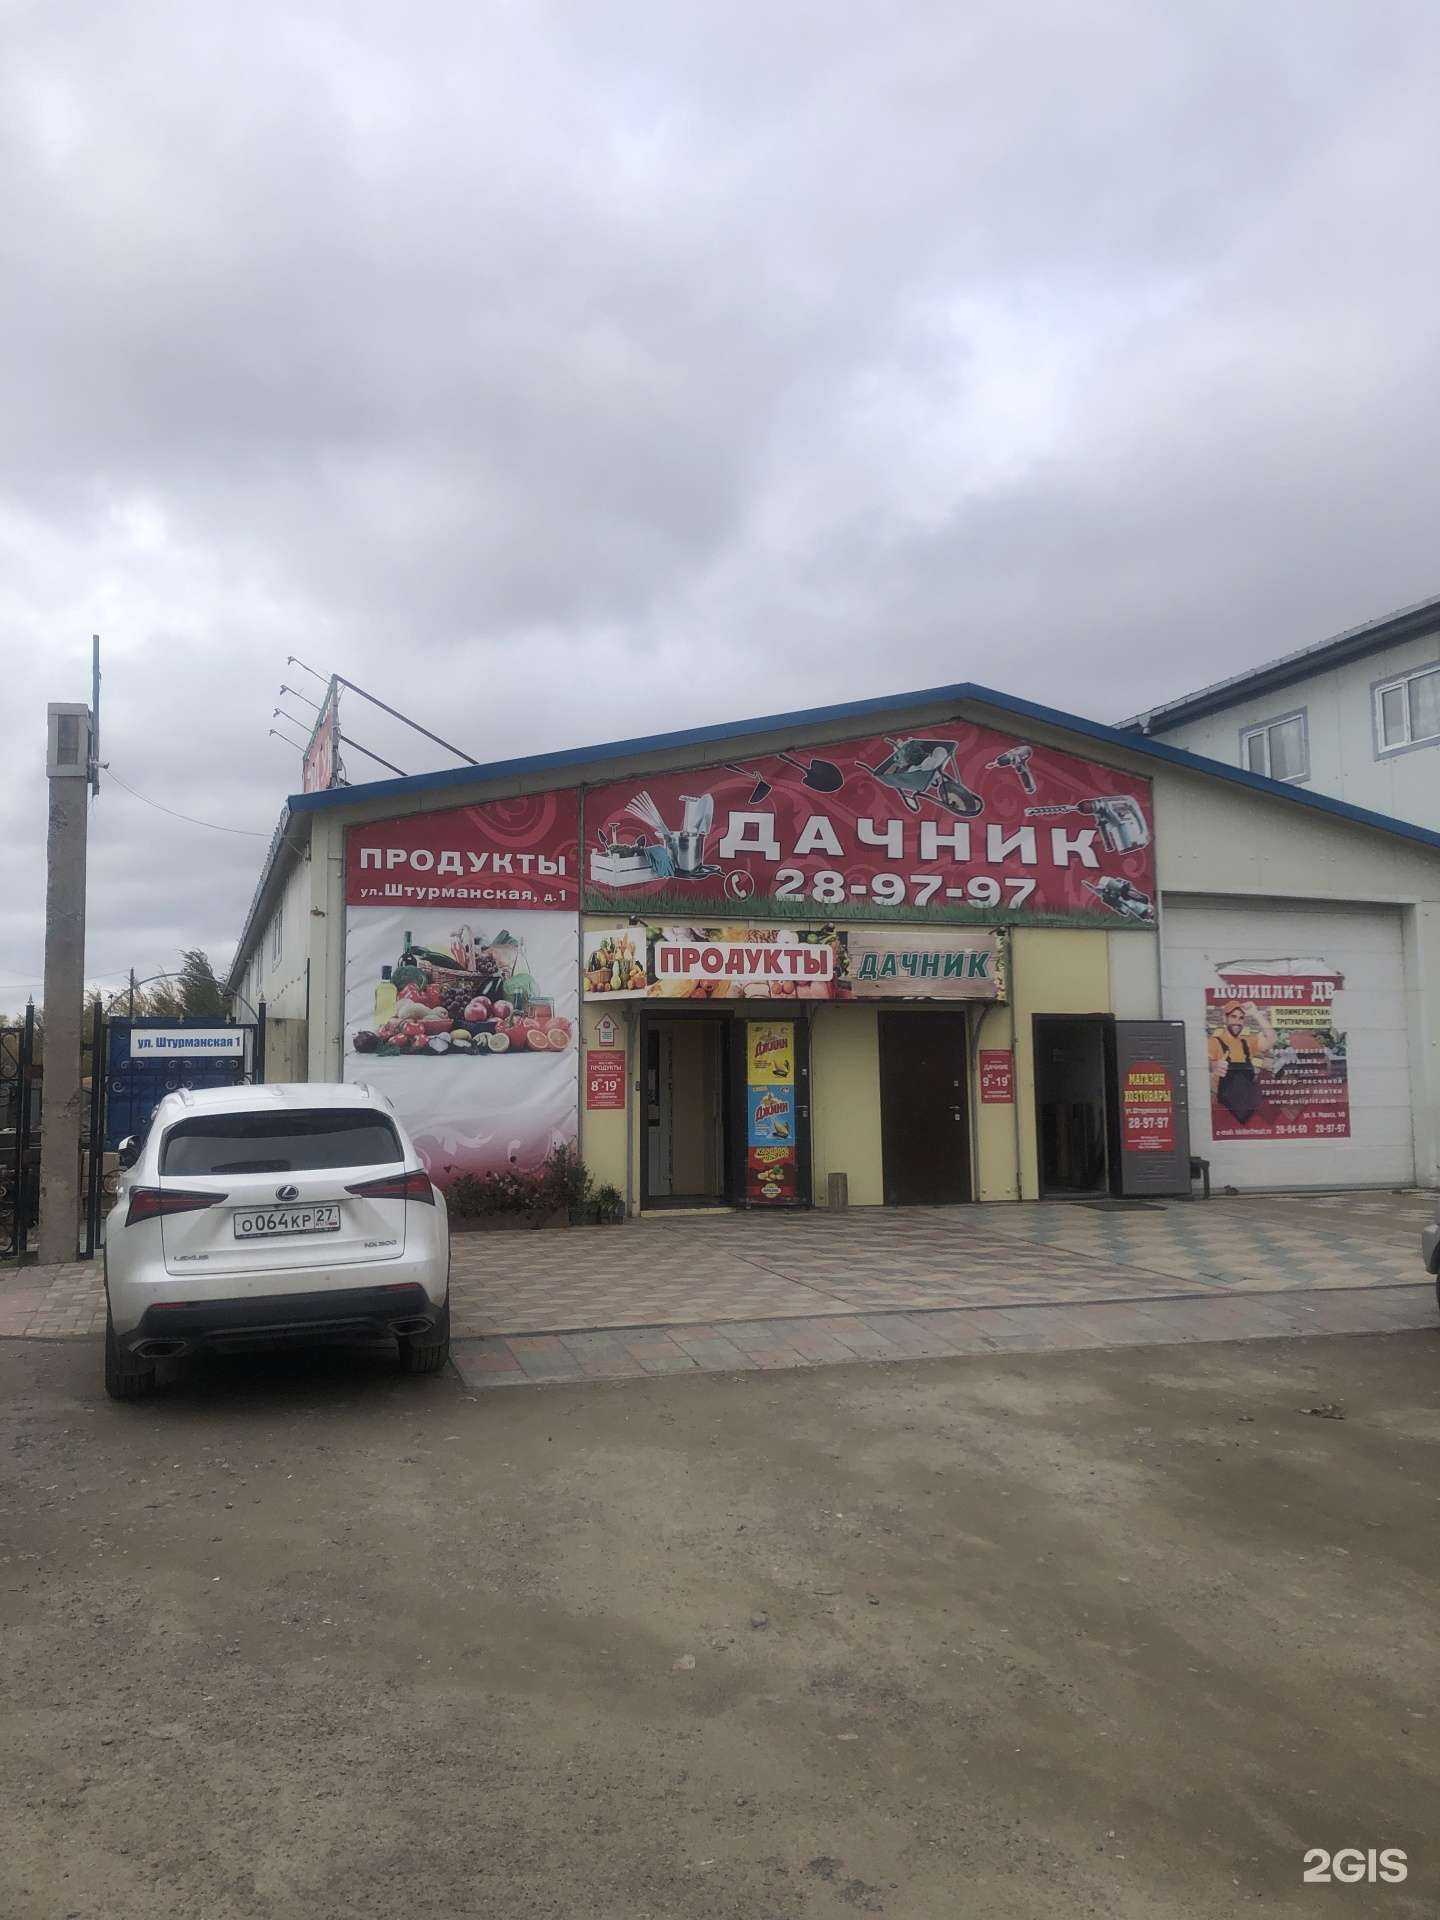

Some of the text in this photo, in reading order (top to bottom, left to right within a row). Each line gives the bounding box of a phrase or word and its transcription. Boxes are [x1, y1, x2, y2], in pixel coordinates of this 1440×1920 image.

[719, 811, 1100, 868] ДАЧНИК
[360, 848, 566, 876] ПРОДУКТЫ
[774, 868, 1036, 910] 28-97-97
[660, 946, 828, 975] ПРОДУКТЫ
[858, 951, 991, 981] ДАЧНИК
[1311, 981, 1336, 1002] ДВ
[137, 1037, 240, 1049] ул. Штурманская 1
[315, 1208, 333, 1222] 27
